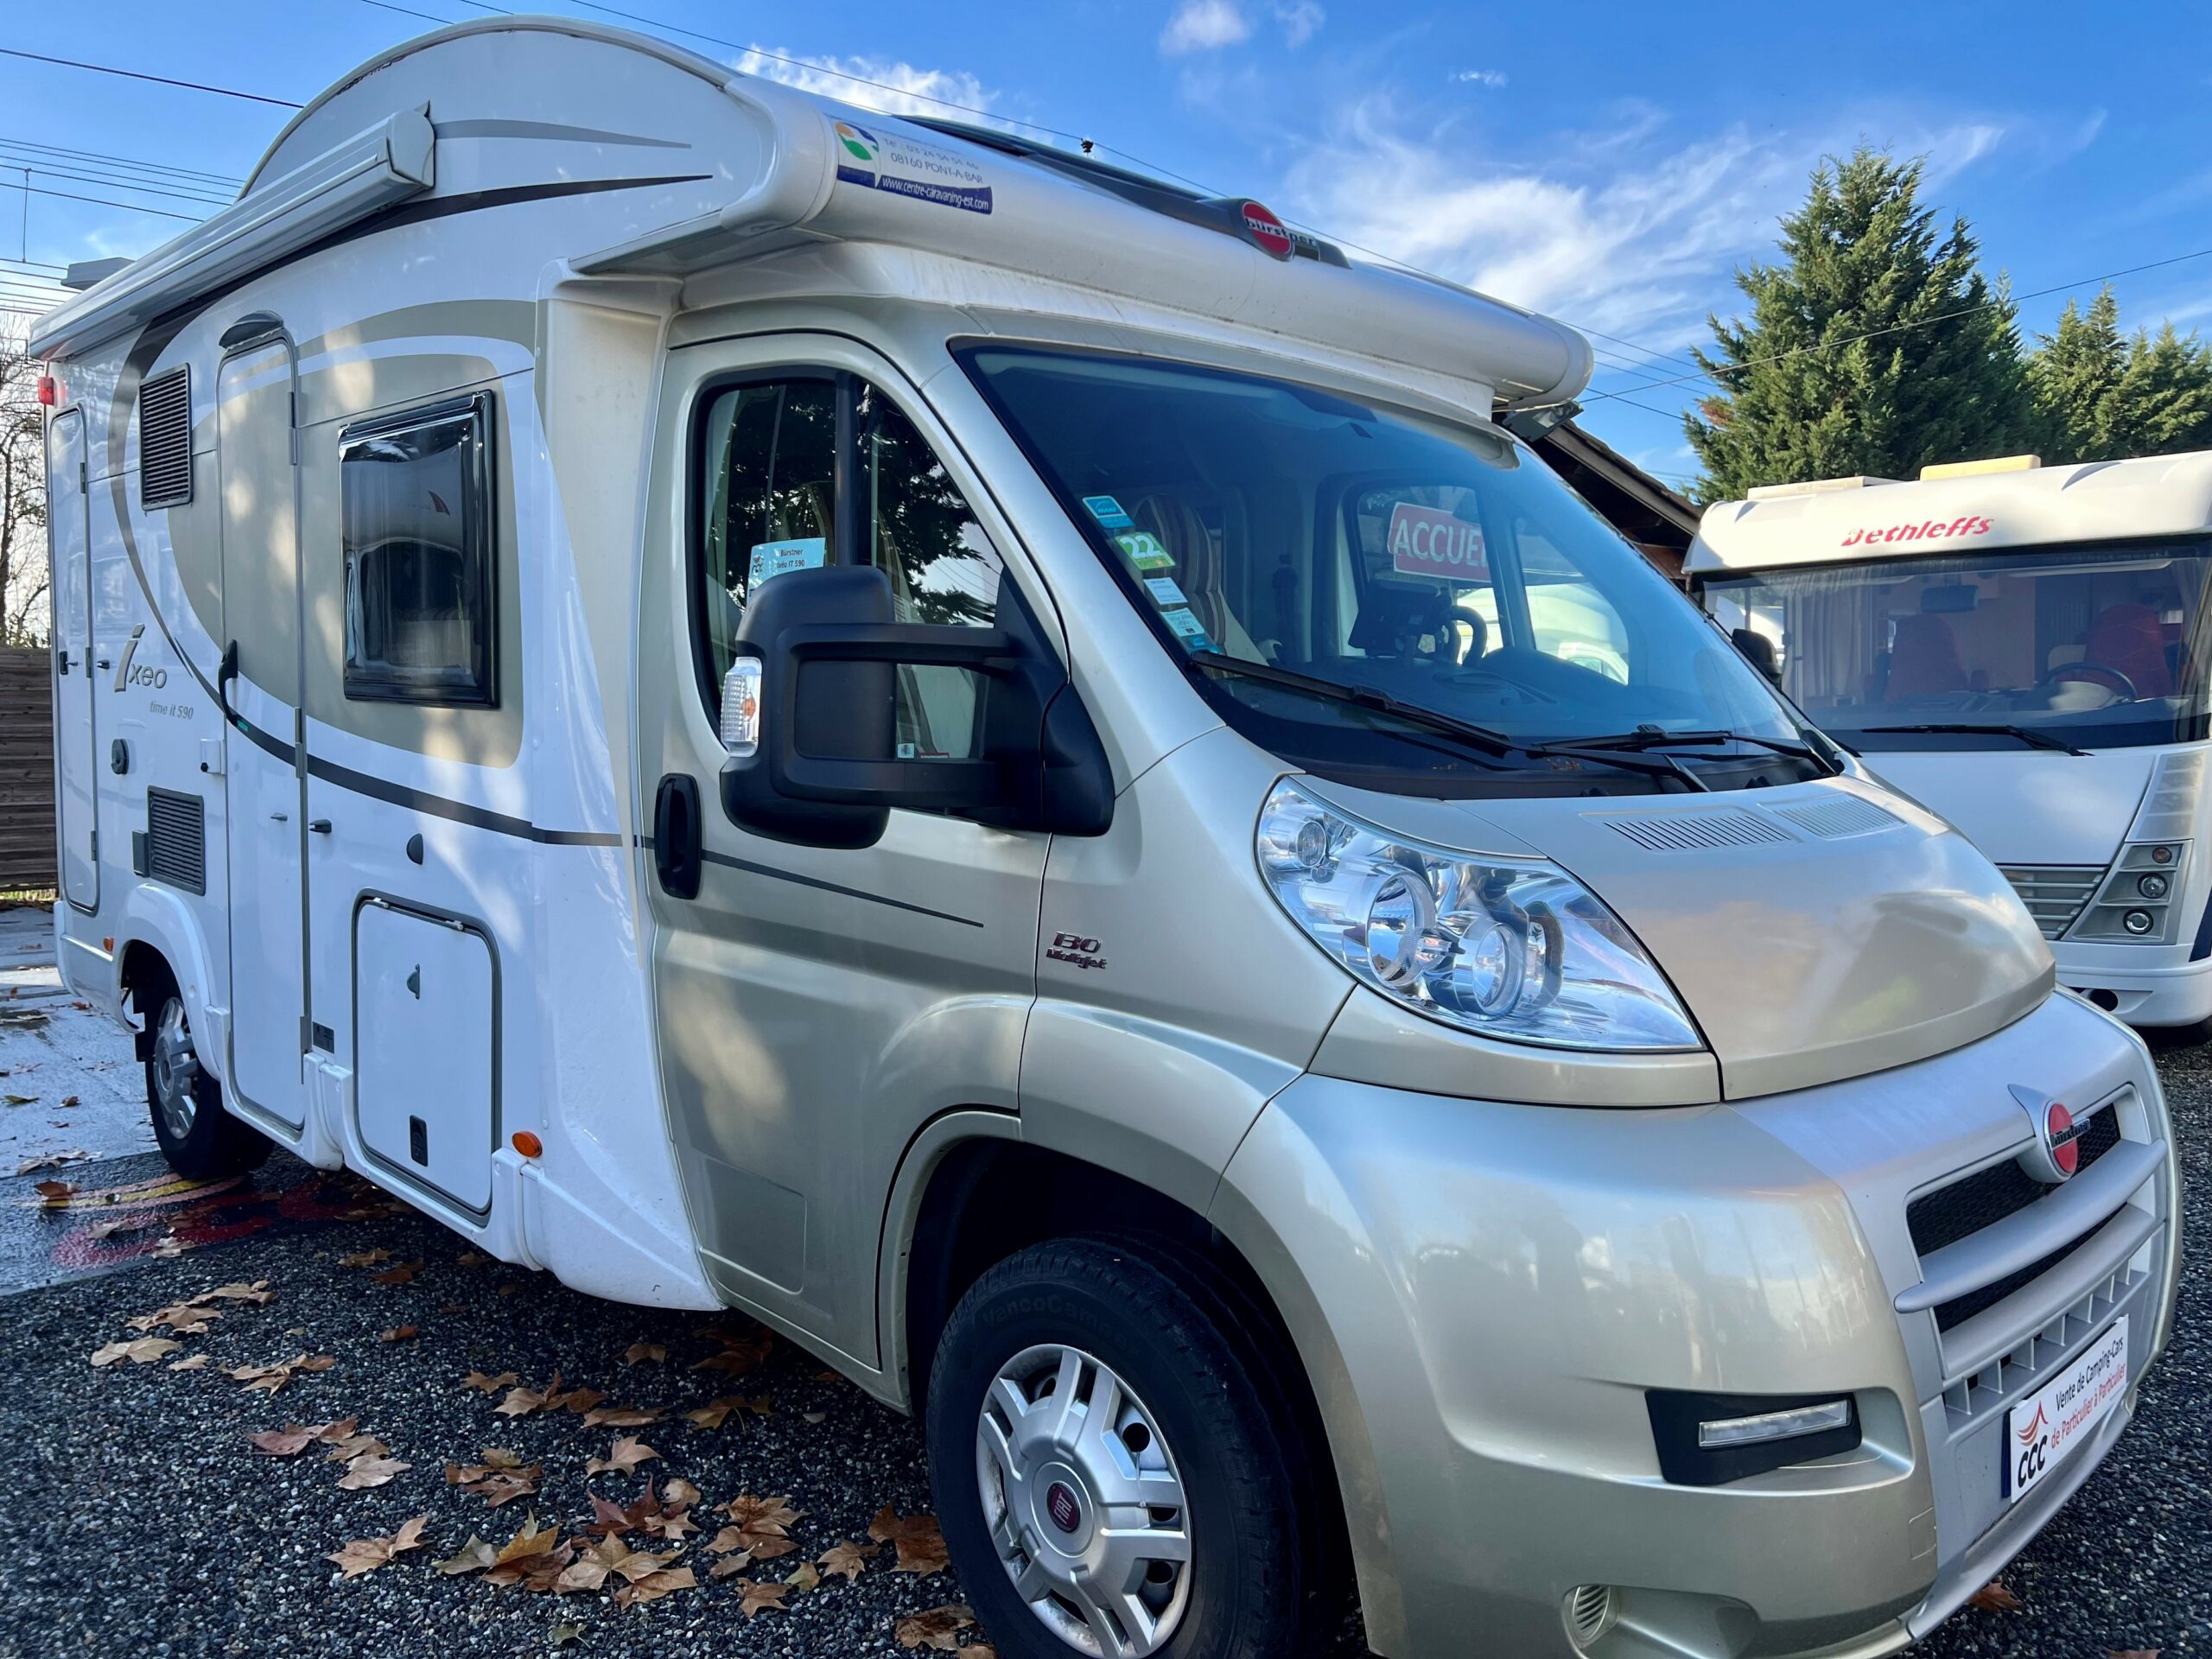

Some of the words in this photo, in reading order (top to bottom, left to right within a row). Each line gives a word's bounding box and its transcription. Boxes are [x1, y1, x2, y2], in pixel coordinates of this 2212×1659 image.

[891, 153, 923, 169] 08160
[925, 161, 983, 184] PONT-A-BAR
[882, 178, 988, 211] www.centre-caravaning-est.com
[1120, 535, 1161, 558] 22
[150, 701, 168, 715] time
[169, 703, 176, 717] it
[177, 705, 194, 720] 590
[2056, 1387, 2075, 1411] Vente
[2076, 1375, 2085, 1394] de
[2086, 1337, 2124, 1384] Camping-Cars
[2051, 1430, 2060, 1449] de
[2062, 1401, 2093, 1440] Particulier
[2094, 1395, 2098, 1409] à
[2099, 1363, 2126, 1401] Particulier
[2018, 1435, 2048, 1489] CCC
[1053, 1492, 1072, 1525] FIAT
